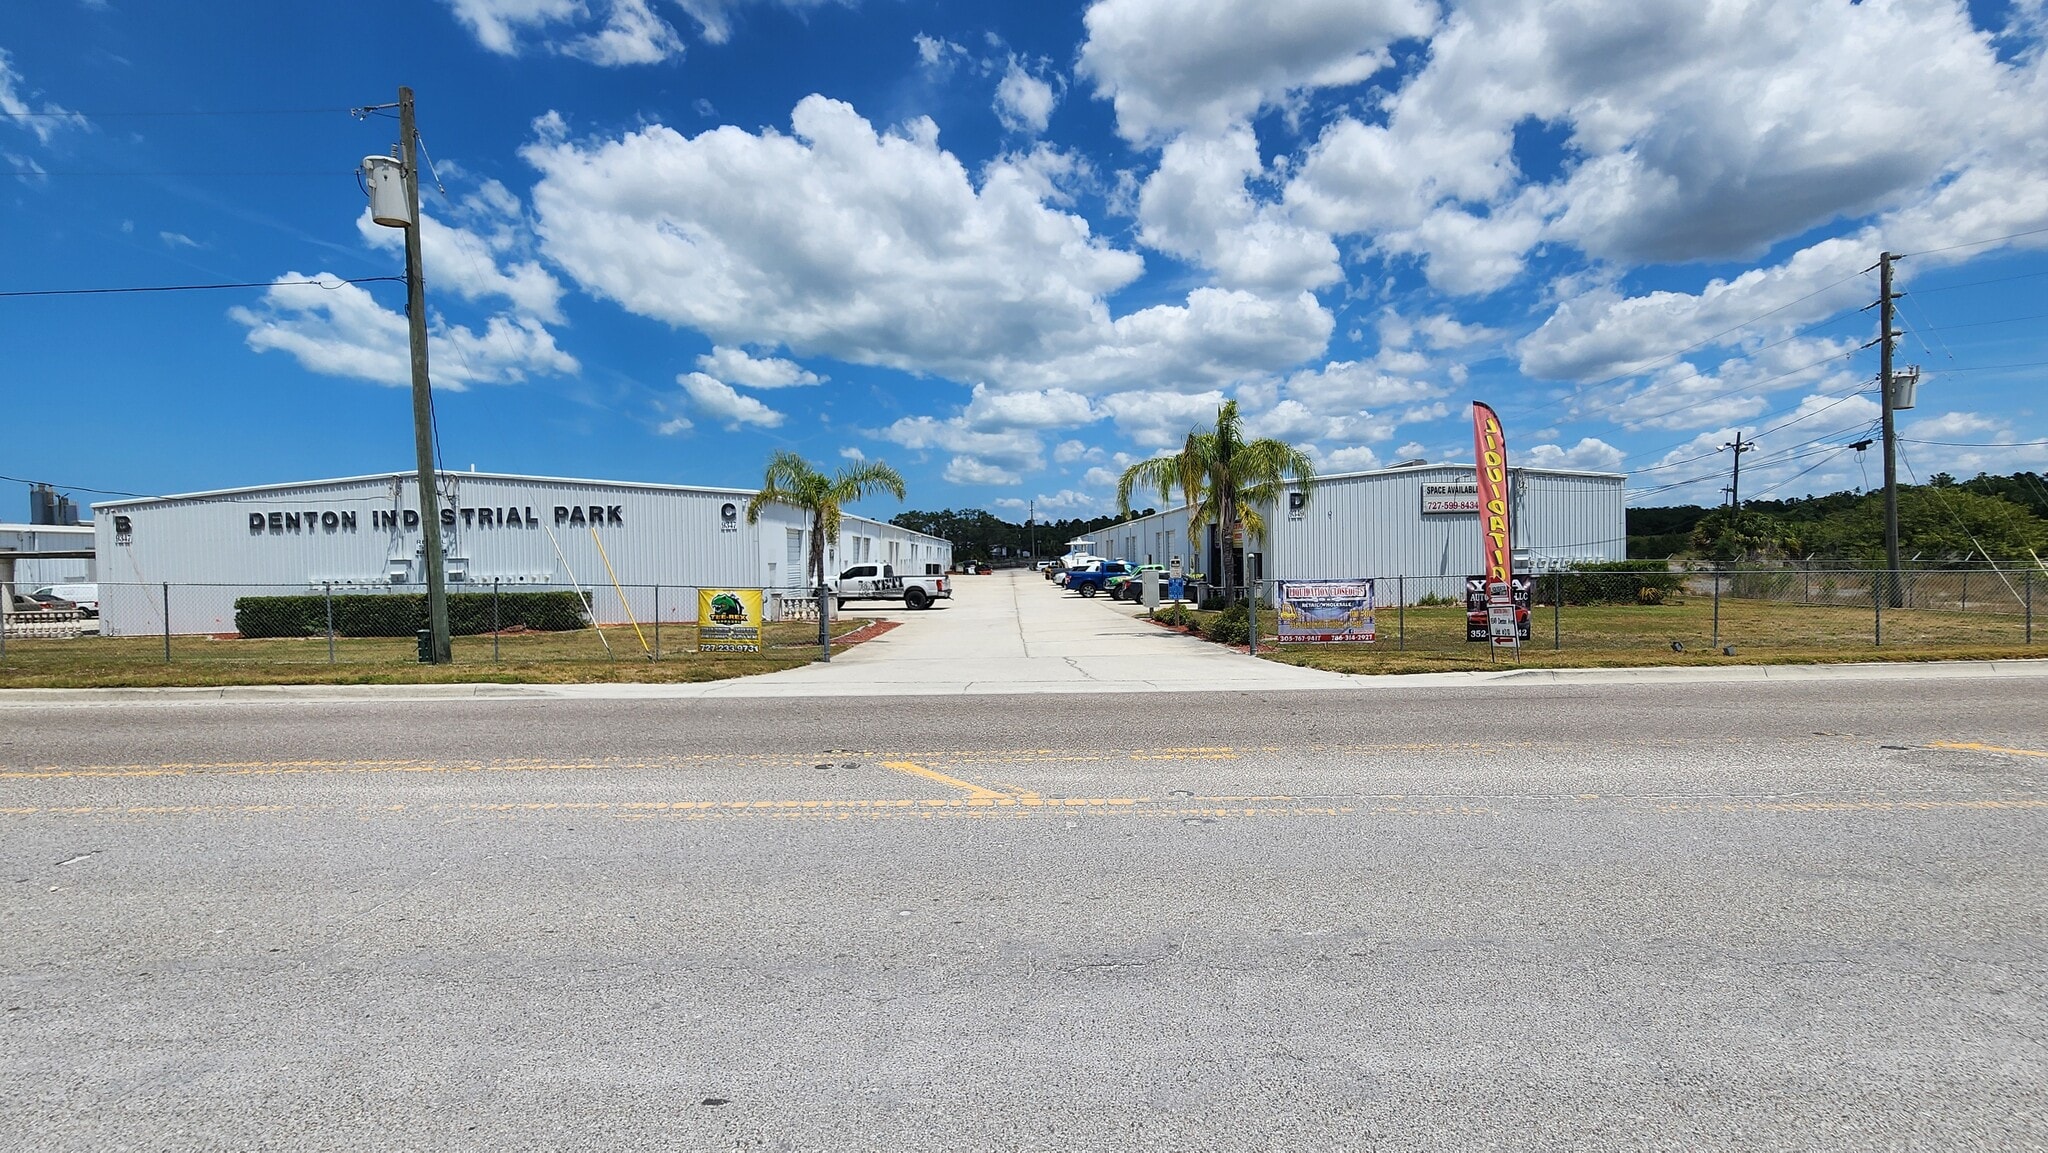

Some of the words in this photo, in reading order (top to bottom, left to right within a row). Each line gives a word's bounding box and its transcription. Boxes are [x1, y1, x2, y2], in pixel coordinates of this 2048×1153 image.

[1426, 486, 1446, 495] SPACE
[1290, 493, 1305, 509] D
[1428, 501, 1478, 510] 727-599-8434
[249, 509, 357, 531] DENTON
[372, 506, 539, 528] INDSTRIAL
[554, 504, 624, 523] PARK
[721, 503, 736, 518] C
[115, 516, 132, 533] B
[872, 577, 903, 591] YETI
[1289, 587, 1329, 598] LIQUIDATION
